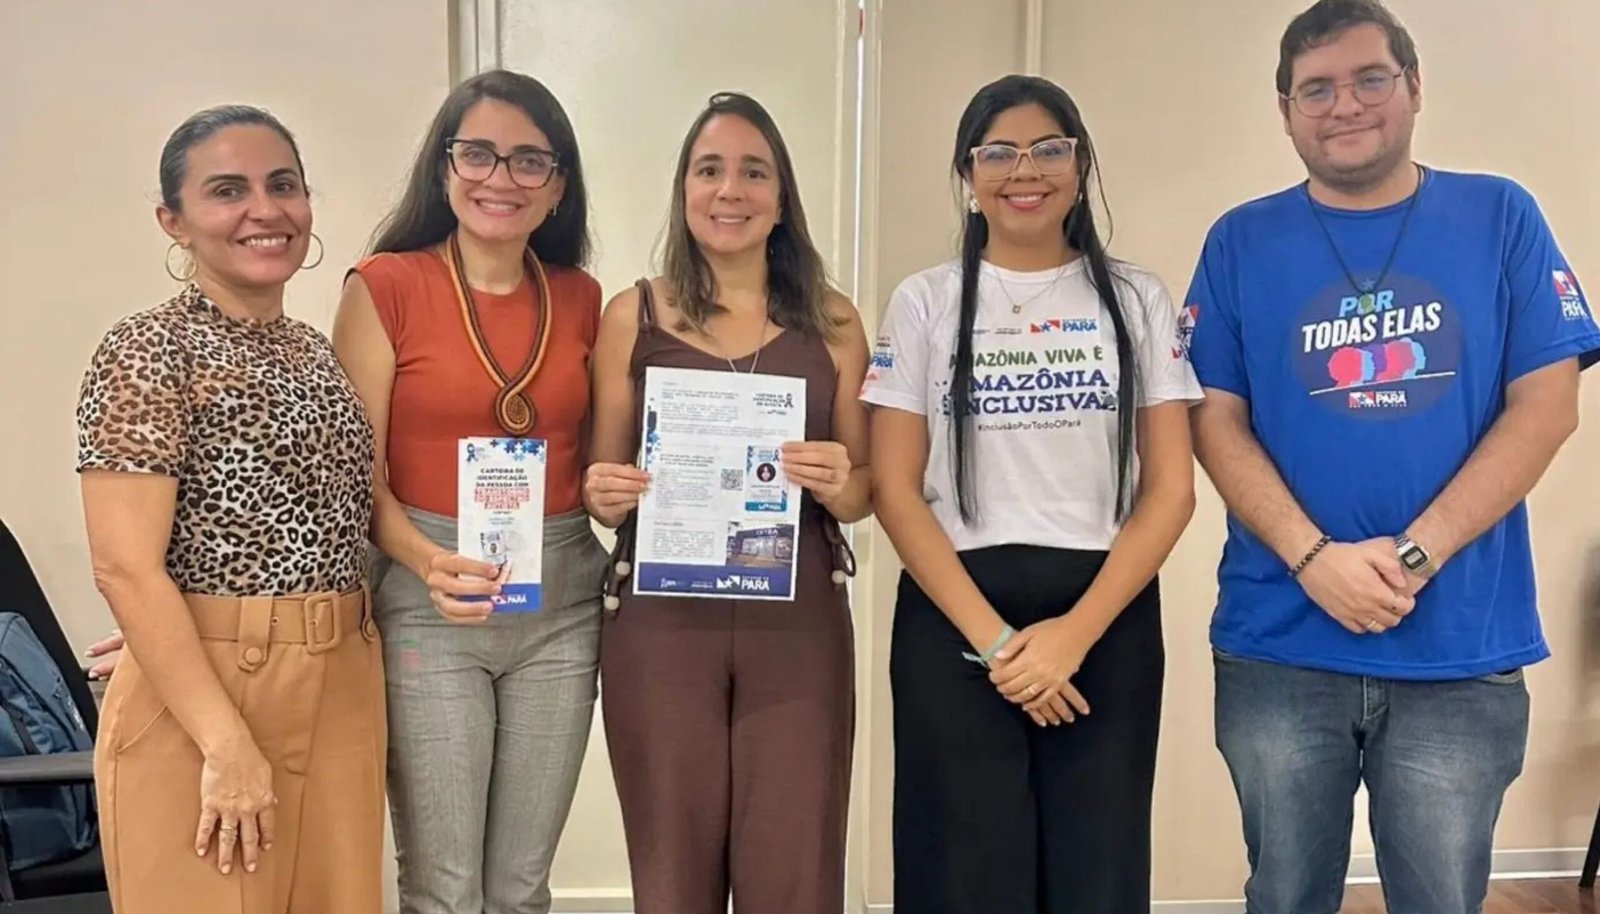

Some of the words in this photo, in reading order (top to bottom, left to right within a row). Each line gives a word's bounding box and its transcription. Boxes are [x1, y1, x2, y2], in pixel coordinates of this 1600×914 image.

[1339, 289, 1394, 317] POR
[1302, 314, 1378, 353] TODAS
[1382, 301, 1442, 339] ELAS
[949, 348, 1037, 370] AAZÔNIA
[1045, 347, 1086, 364] VIVA
[1093, 345, 1104, 361] É
[969, 367, 1110, 393] MAZÔNIA
[964, 391, 1103, 416] NCLUSIVA
